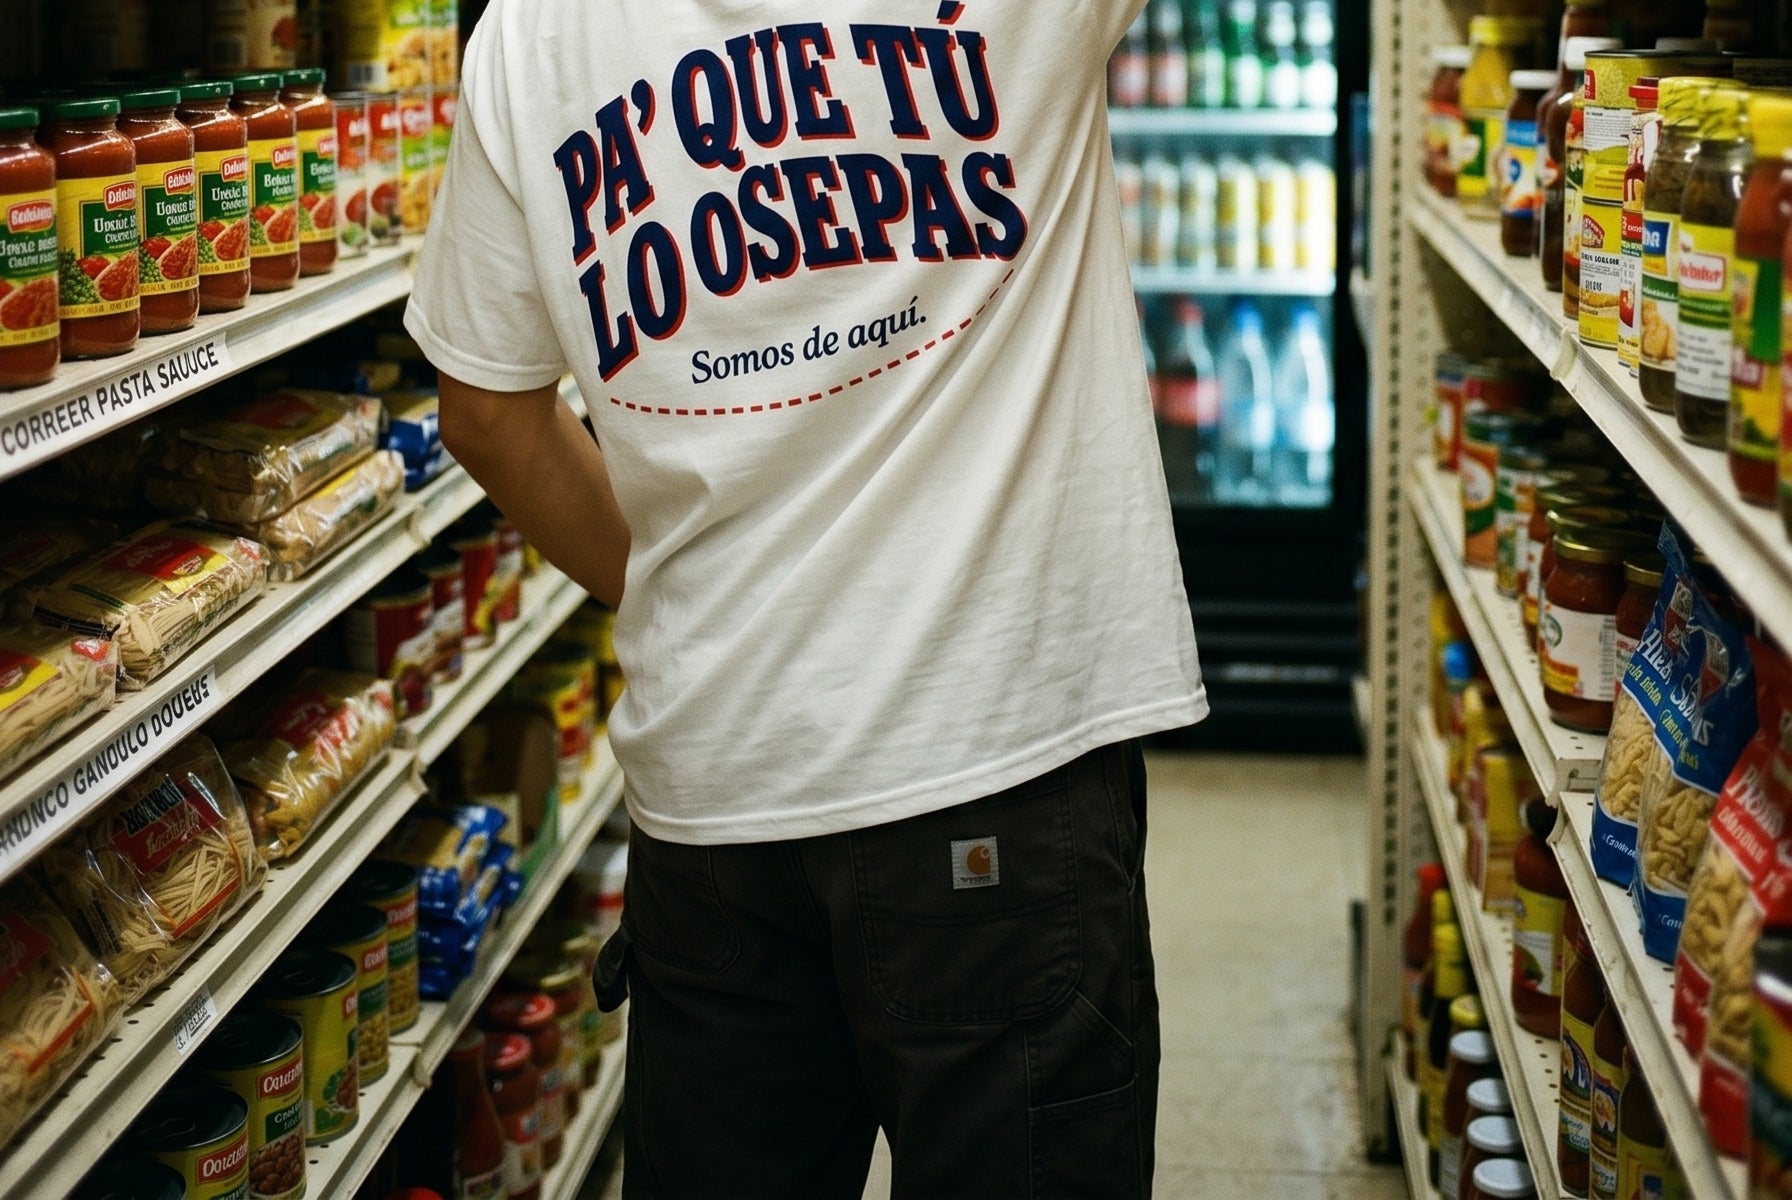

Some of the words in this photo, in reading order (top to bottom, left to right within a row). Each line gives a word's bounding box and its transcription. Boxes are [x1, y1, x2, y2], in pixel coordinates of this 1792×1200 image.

[671, 21, 856, 172] QUE
[849, 0, 1000, 141] TÚ
[579, 220, 686, 383] LO
[690, 152, 1028, 297] OSEPAS
[691, 341, 794, 384] Somos
[803, 325, 839, 362] de
[848, 295, 927, 350] aquí.
[1, 395, 95, 456] CORREER
[96, 369, 156, 416] PASTA
